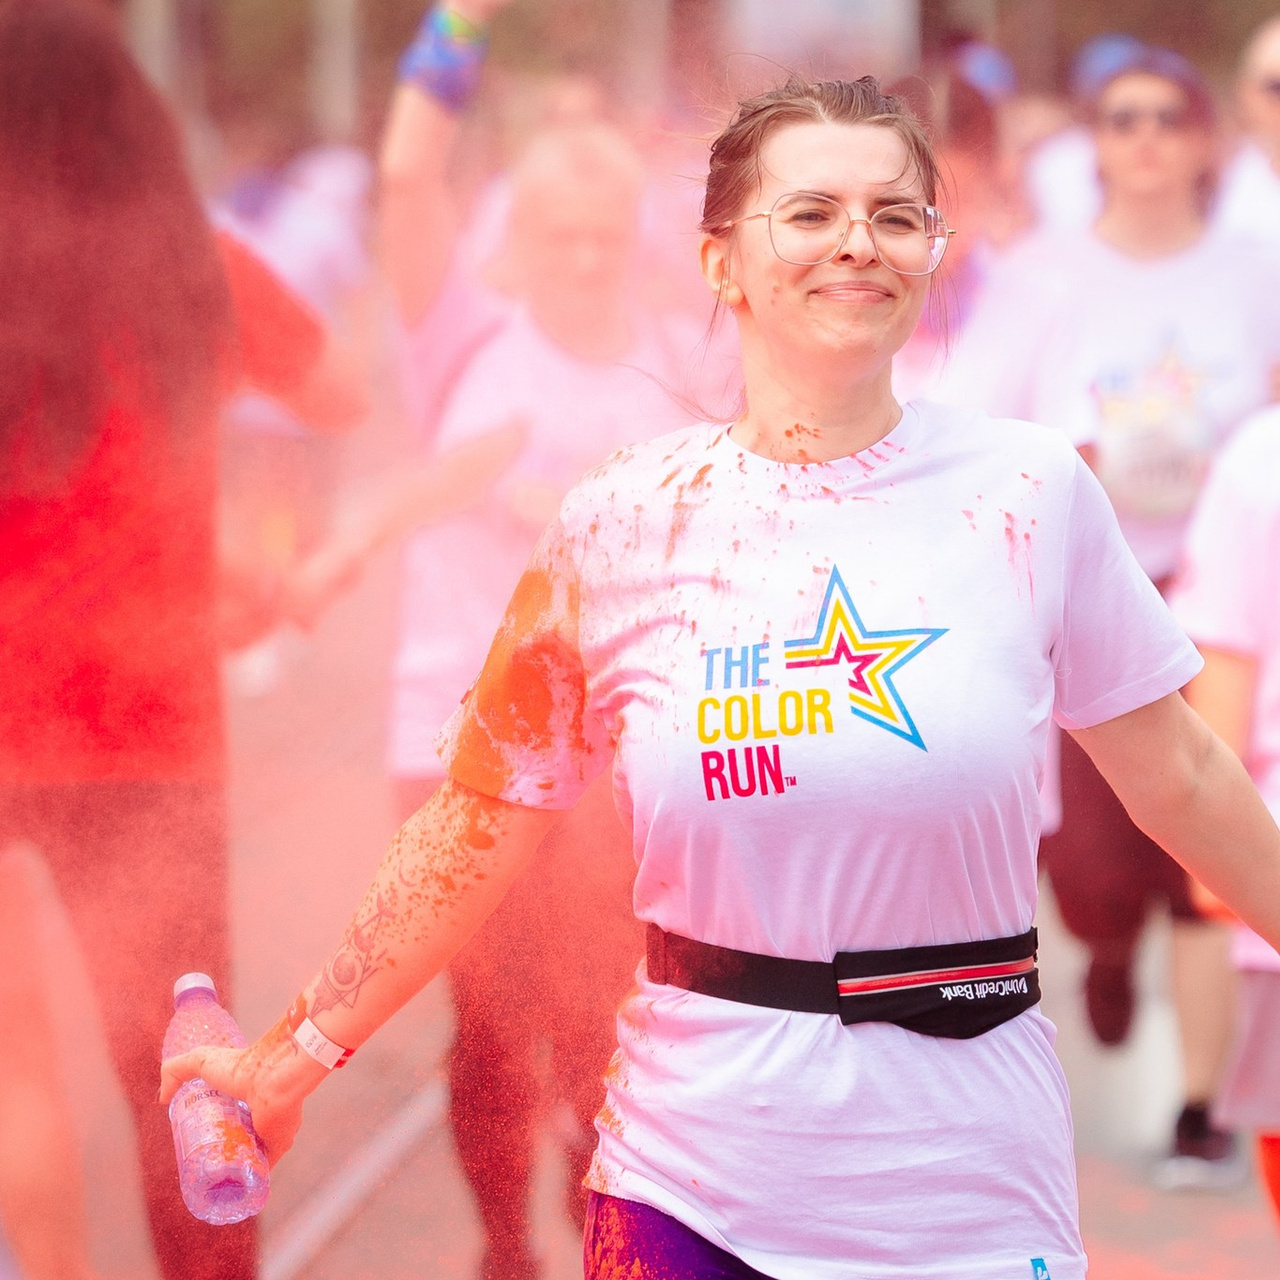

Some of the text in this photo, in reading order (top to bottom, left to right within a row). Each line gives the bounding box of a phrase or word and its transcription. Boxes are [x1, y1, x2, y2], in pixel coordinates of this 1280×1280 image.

[700, 642, 770, 691] THE
[697, 688, 834, 745] COLOR
[701, 744, 785, 801] RUN
[939, 978, 1021, 1001] UniCredit Bank
